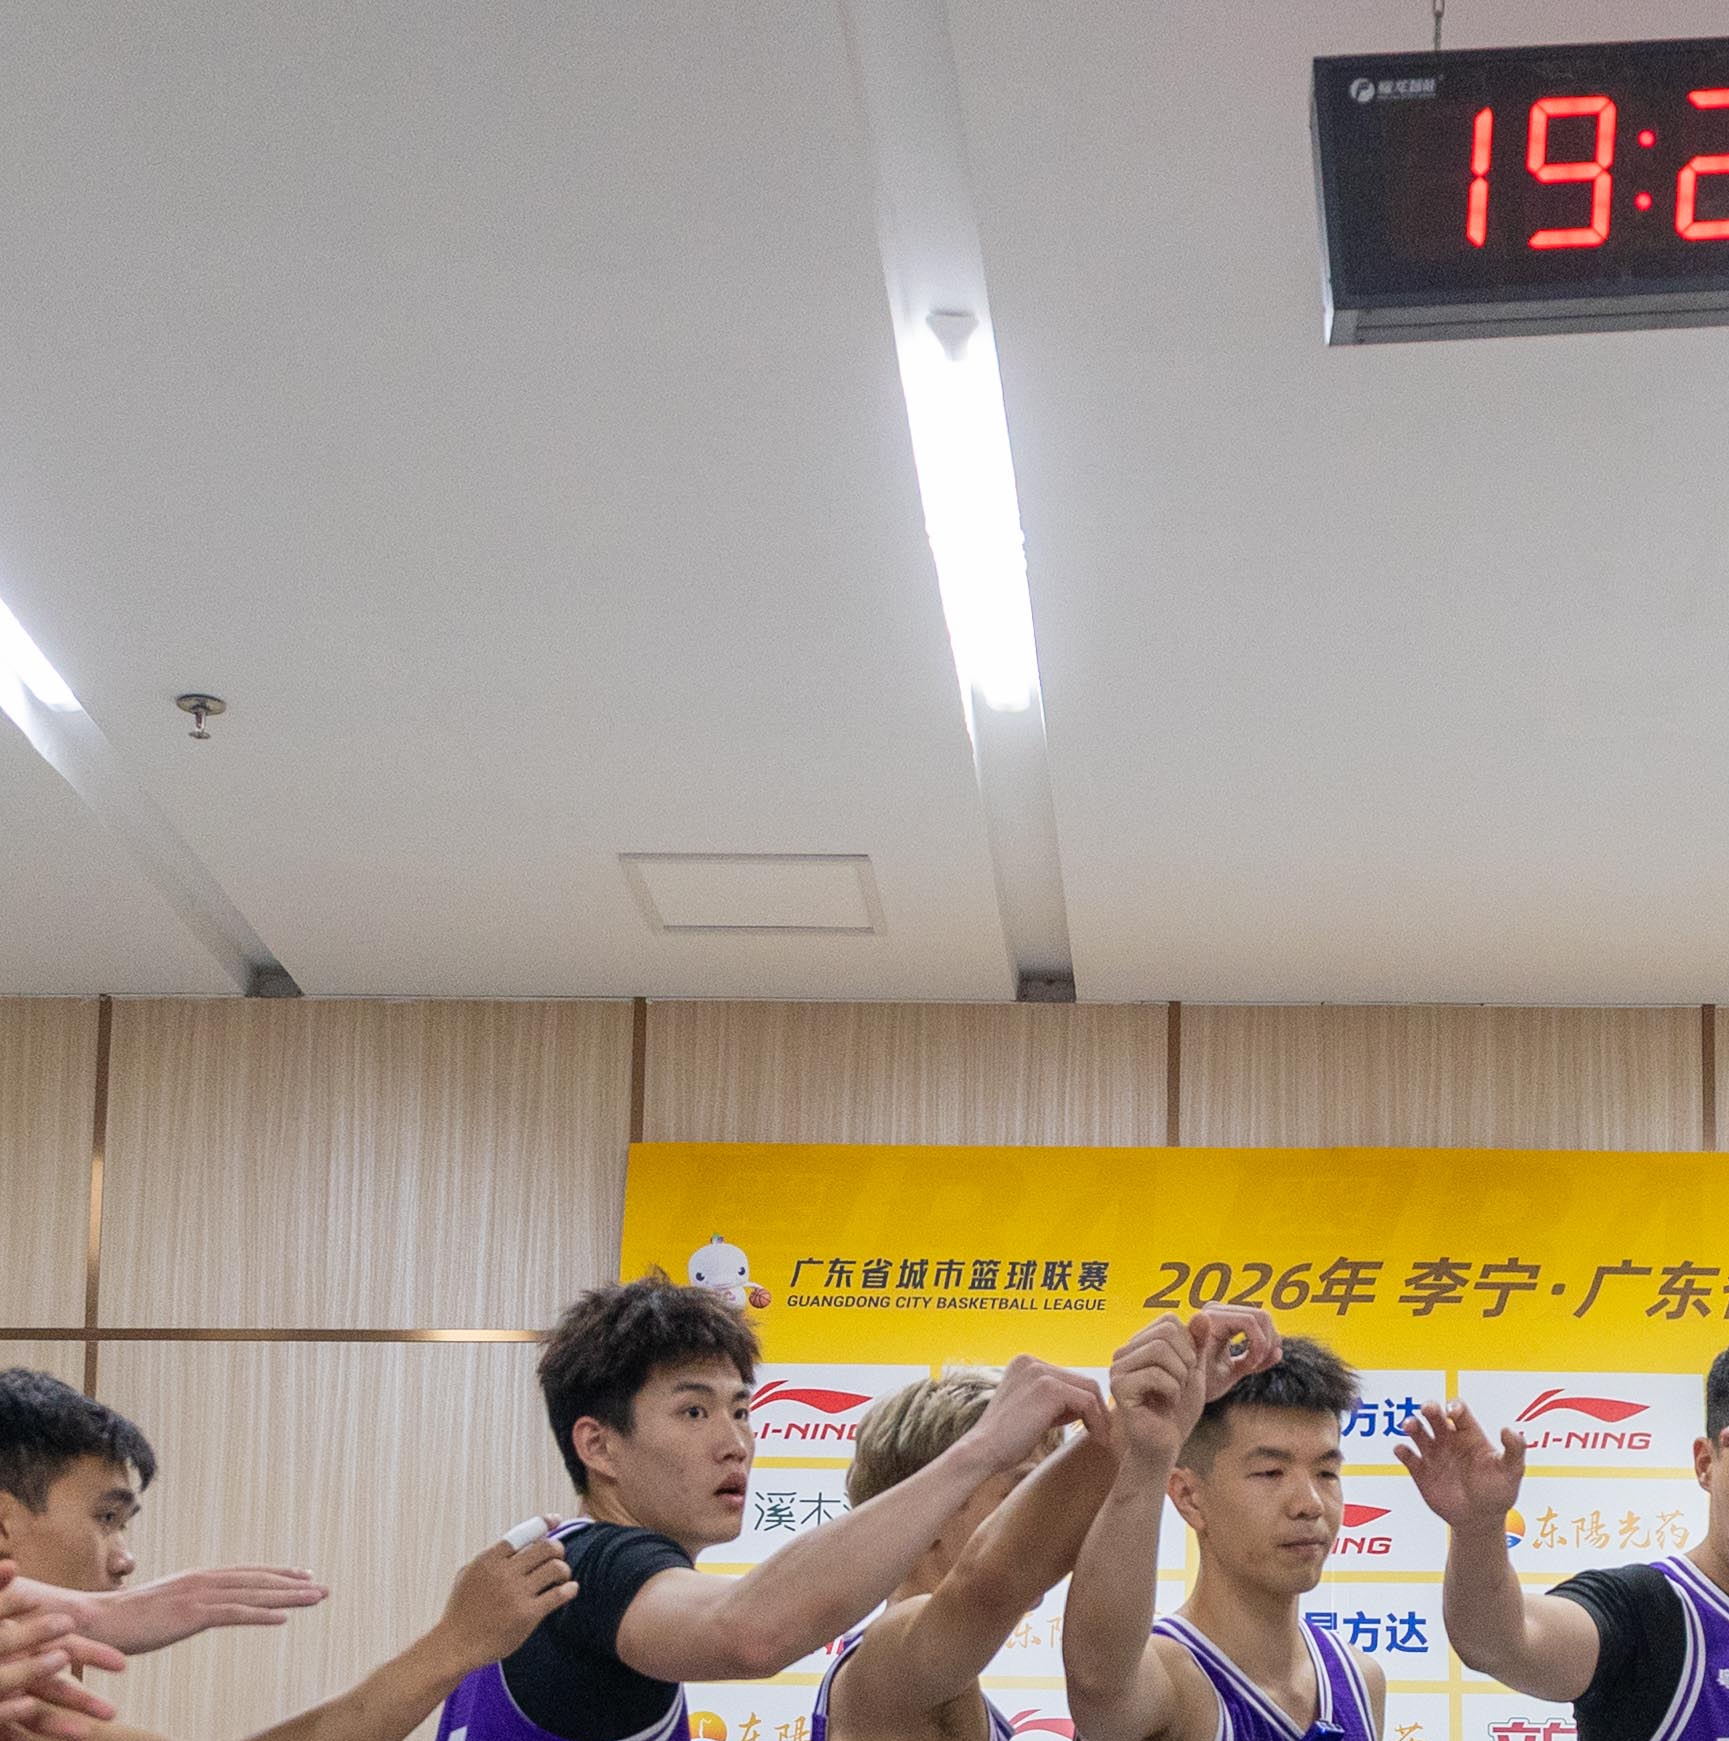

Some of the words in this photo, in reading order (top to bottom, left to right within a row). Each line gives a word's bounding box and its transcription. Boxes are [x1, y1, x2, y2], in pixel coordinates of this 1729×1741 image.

[790, 1257, 1110, 1292] 广东省城市篮球联赛
[1143, 1255, 1384, 1316] 2026年
[787, 1294, 891, 1308] GUANGDONG
[895, 1296, 933, 1309] CITY
[936, 1297, 1038, 1310] BASKETBALL
[1043, 1298, 1107, 1311] LEAGUE
